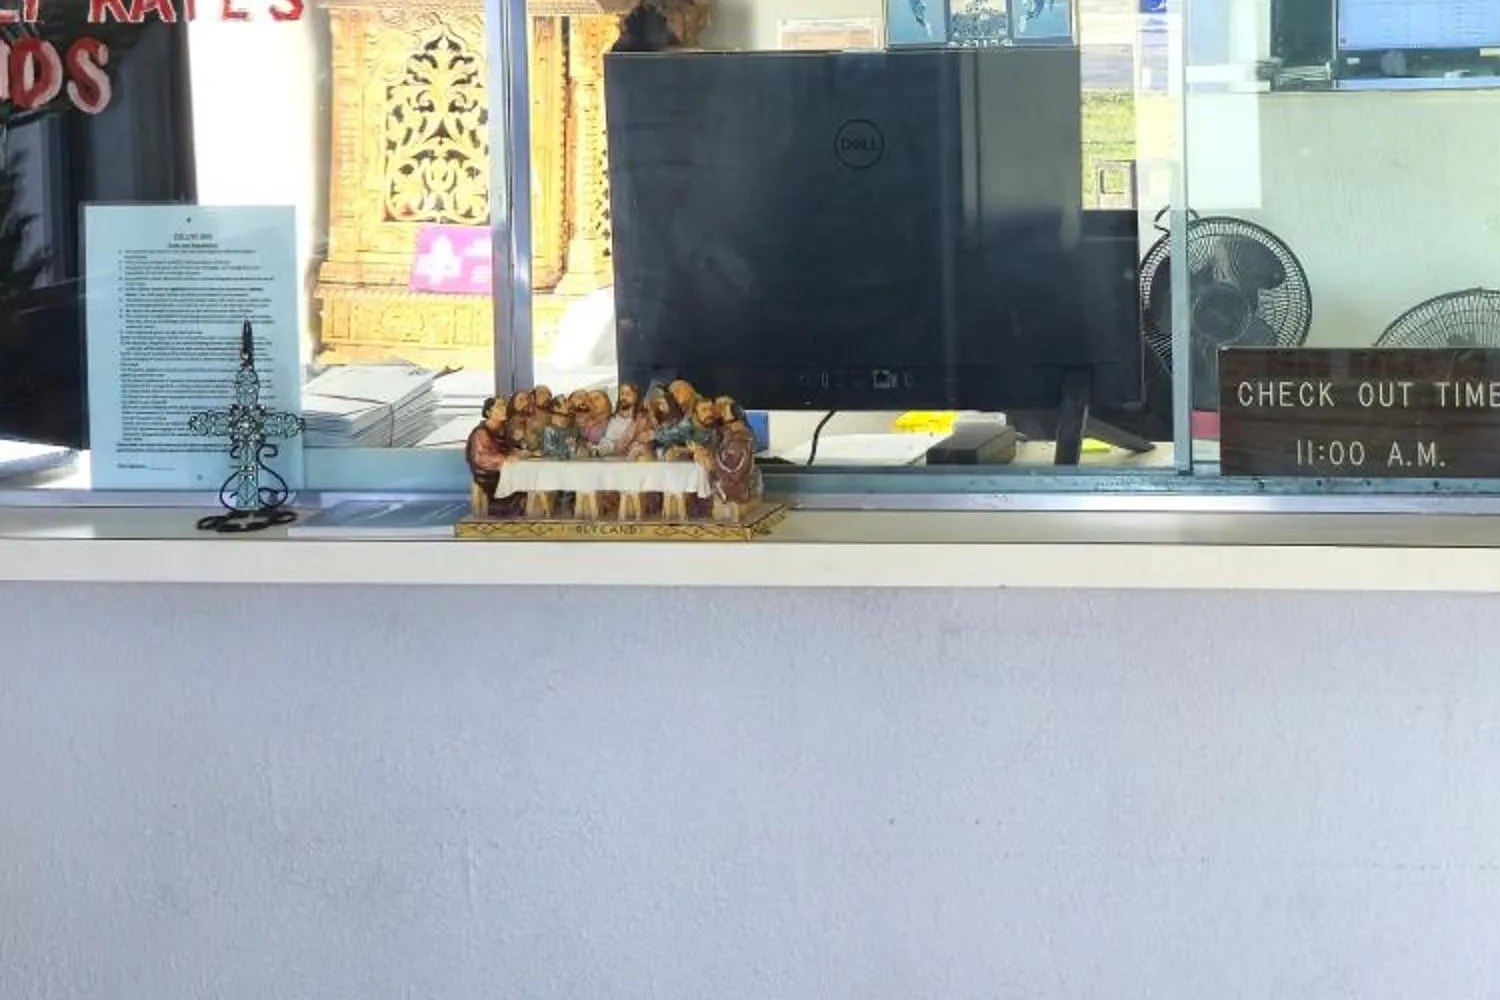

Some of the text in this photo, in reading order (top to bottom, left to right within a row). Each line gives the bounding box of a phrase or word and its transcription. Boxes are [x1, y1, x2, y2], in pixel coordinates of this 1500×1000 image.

[0, 36, 112, 115] DS
[1237, 380, 1336, 408] CHECK
[1357, 381, 1416, 408] OUT
[1296, 439, 1447, 467] 11:00 A.M.
